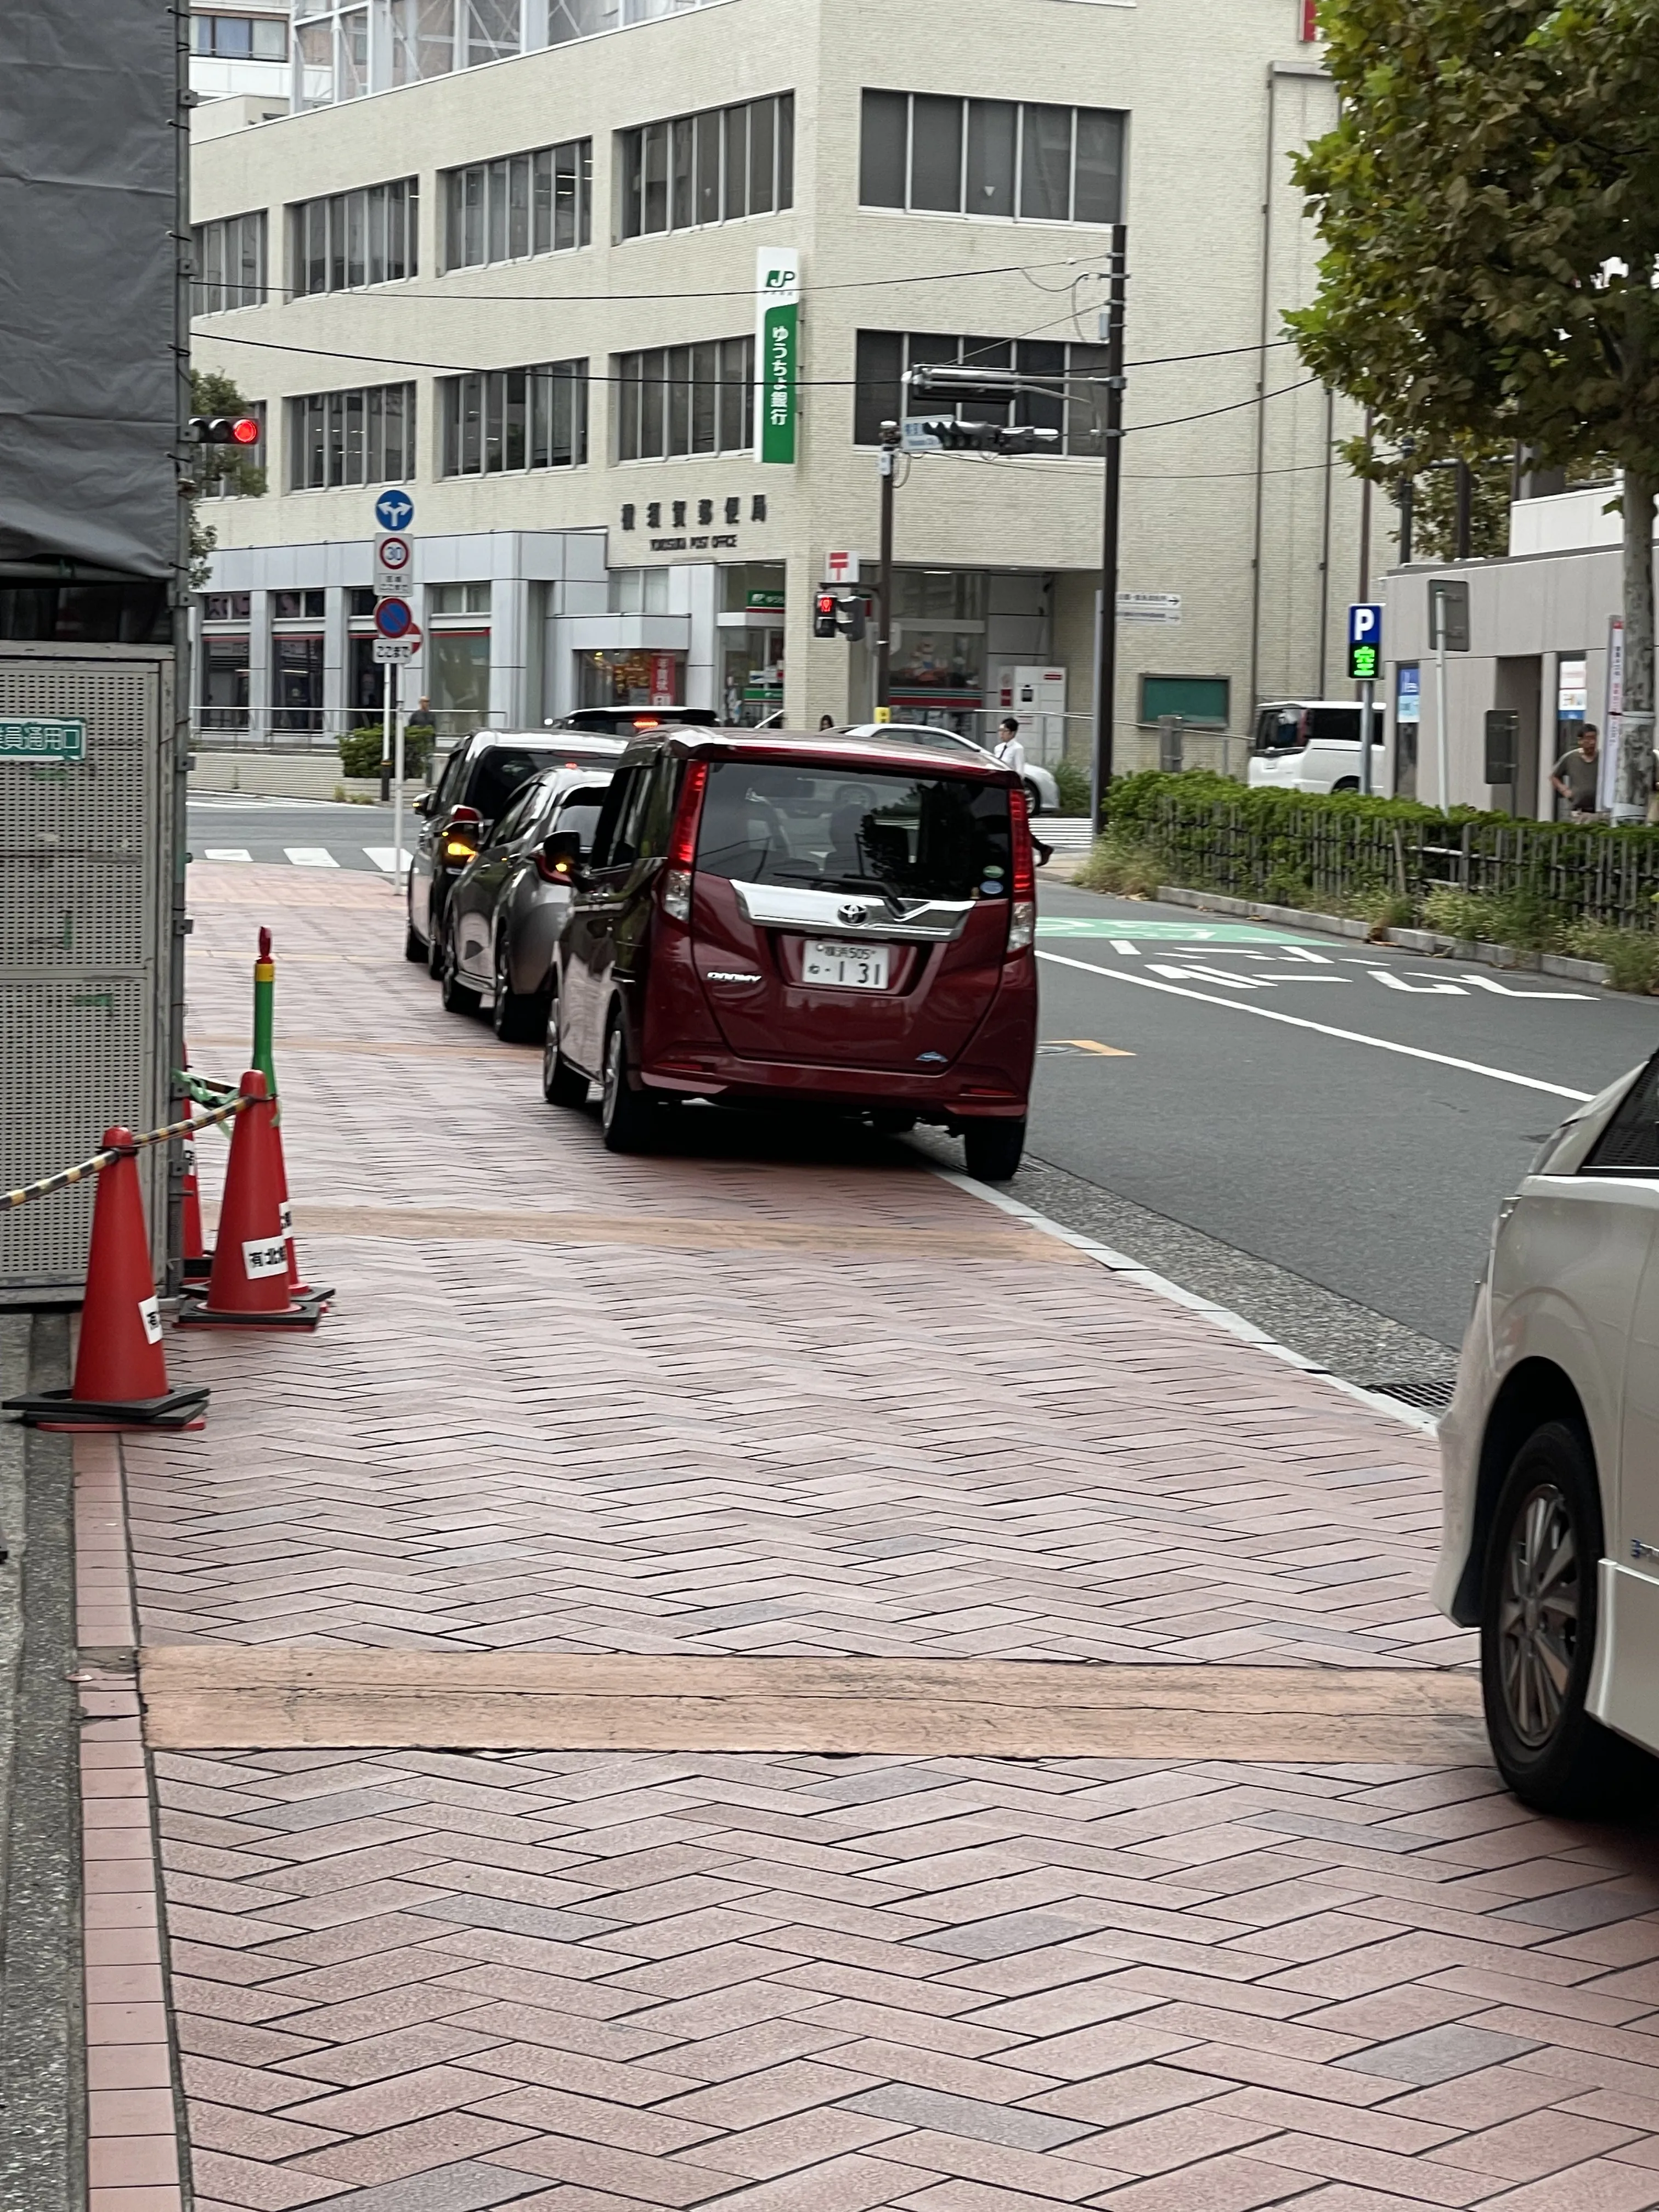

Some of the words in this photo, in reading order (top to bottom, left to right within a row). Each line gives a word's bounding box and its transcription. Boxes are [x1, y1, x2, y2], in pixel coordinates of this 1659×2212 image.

[765, 270, 796, 288] JP
[770, 325, 789, 426] ゆうちょ銀行
[386, 546, 403, 561] 30
[1354, 608, 1375, 641] P
[1354, 646, 1375, 676] 空
[0, 726, 80, 751] 員通用口
